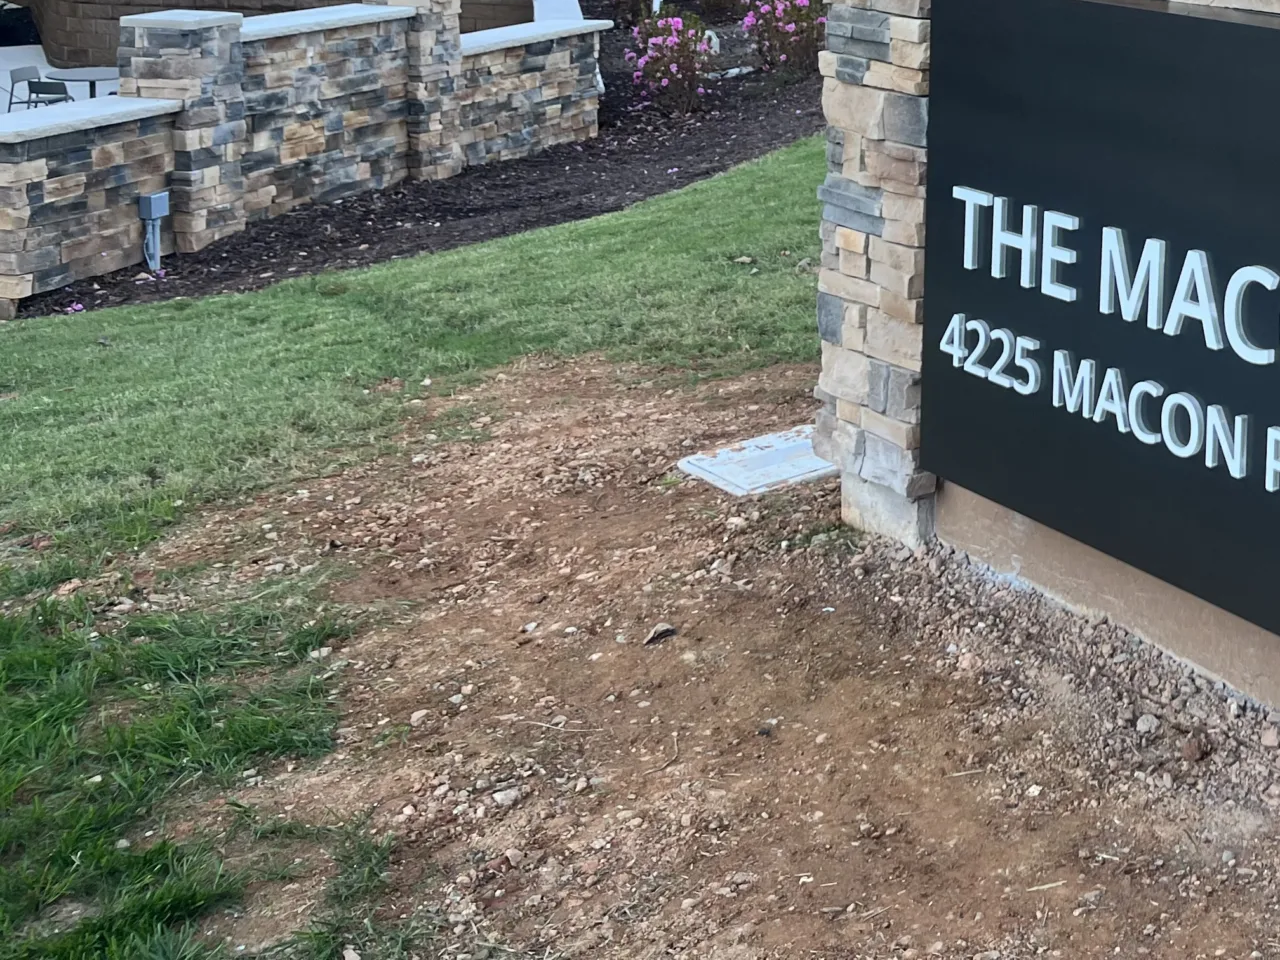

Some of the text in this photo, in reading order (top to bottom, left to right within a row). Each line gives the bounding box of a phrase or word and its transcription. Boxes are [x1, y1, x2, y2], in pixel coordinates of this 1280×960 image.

[952, 185, 1080, 302] THE
[939, 312, 1041, 396] 4225
[1052, 348, 1248, 480] MACON
